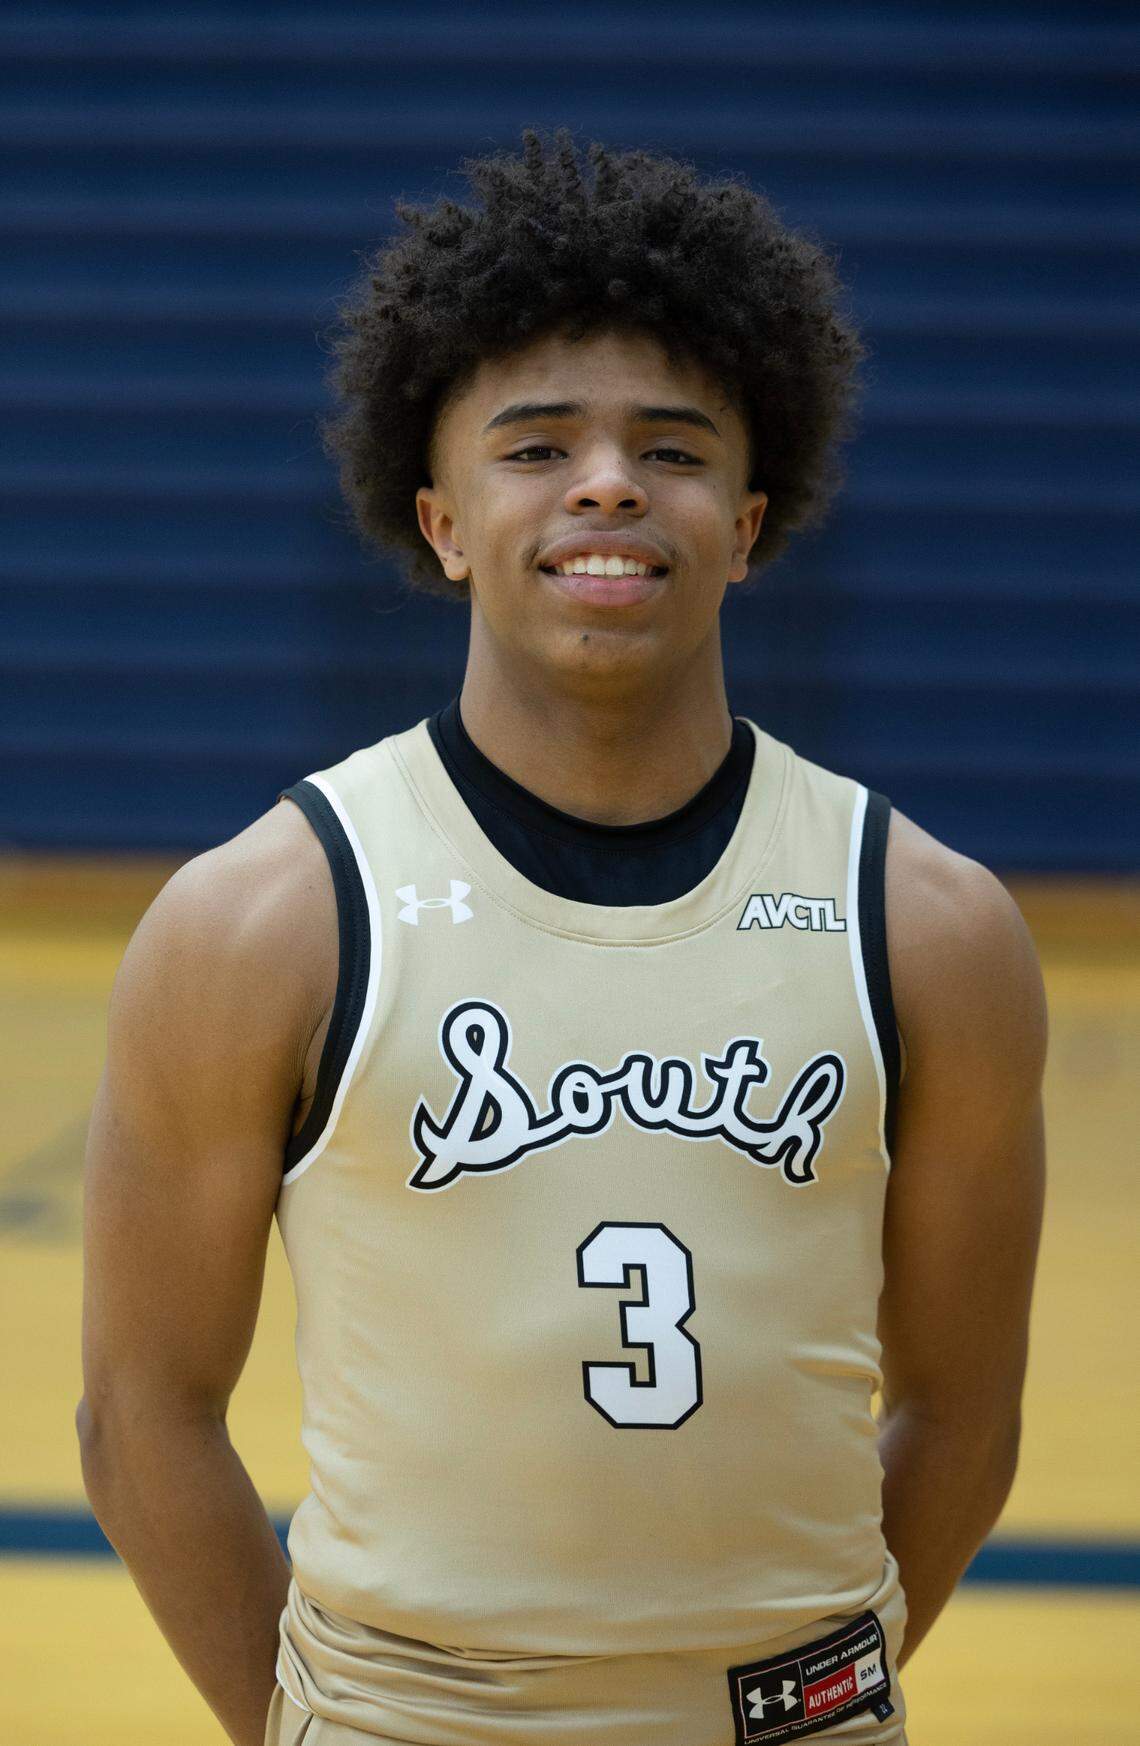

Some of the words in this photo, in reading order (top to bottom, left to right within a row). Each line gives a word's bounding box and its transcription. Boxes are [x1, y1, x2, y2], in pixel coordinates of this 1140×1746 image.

[736, 892, 847, 932] AVCTL
[406, 998, 847, 1193] South
[576, 1221, 703, 1430] 3
[805, 1655, 838, 1676] UNDER
[841, 1634, 877, 1659] ARMOUR
[860, 1664, 877, 1680] SM
[808, 1676, 853, 1709] AUTHENTIC
[744, 1727, 789, 1745] UNIVERSAL
